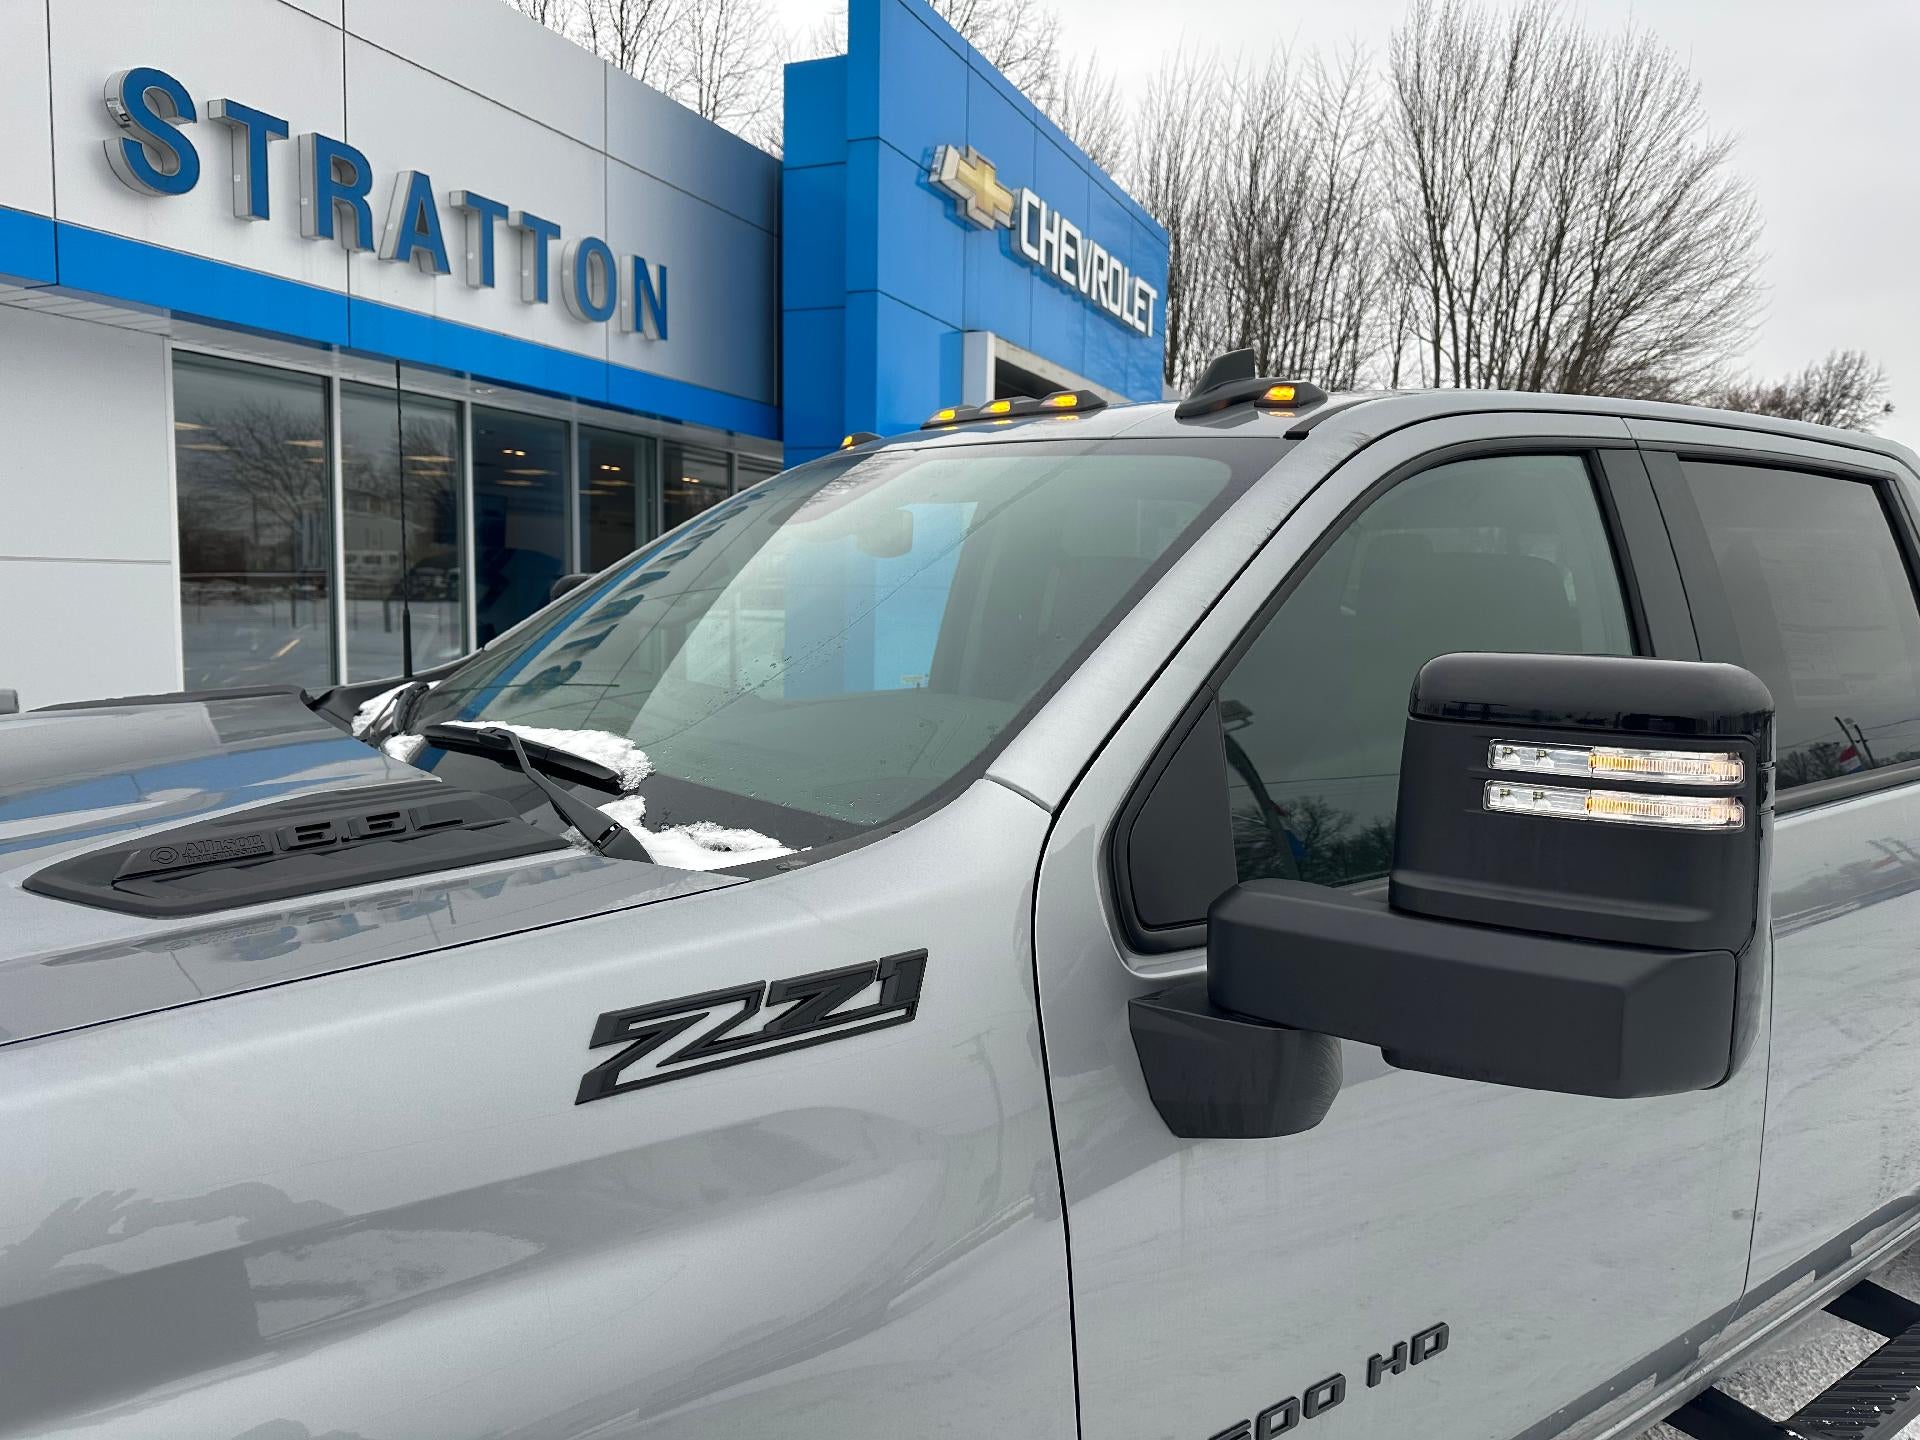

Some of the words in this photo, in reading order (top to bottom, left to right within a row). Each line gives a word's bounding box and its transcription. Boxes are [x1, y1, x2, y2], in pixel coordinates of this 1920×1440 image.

[104, 67, 669, 341] STRATTON
[1014, 187, 1158, 338] CHEVROLET
[184, 834, 265, 856] Allison
[575, 948, 929, 1105] Z71
[1366, 1321, 1450, 1388] HD
